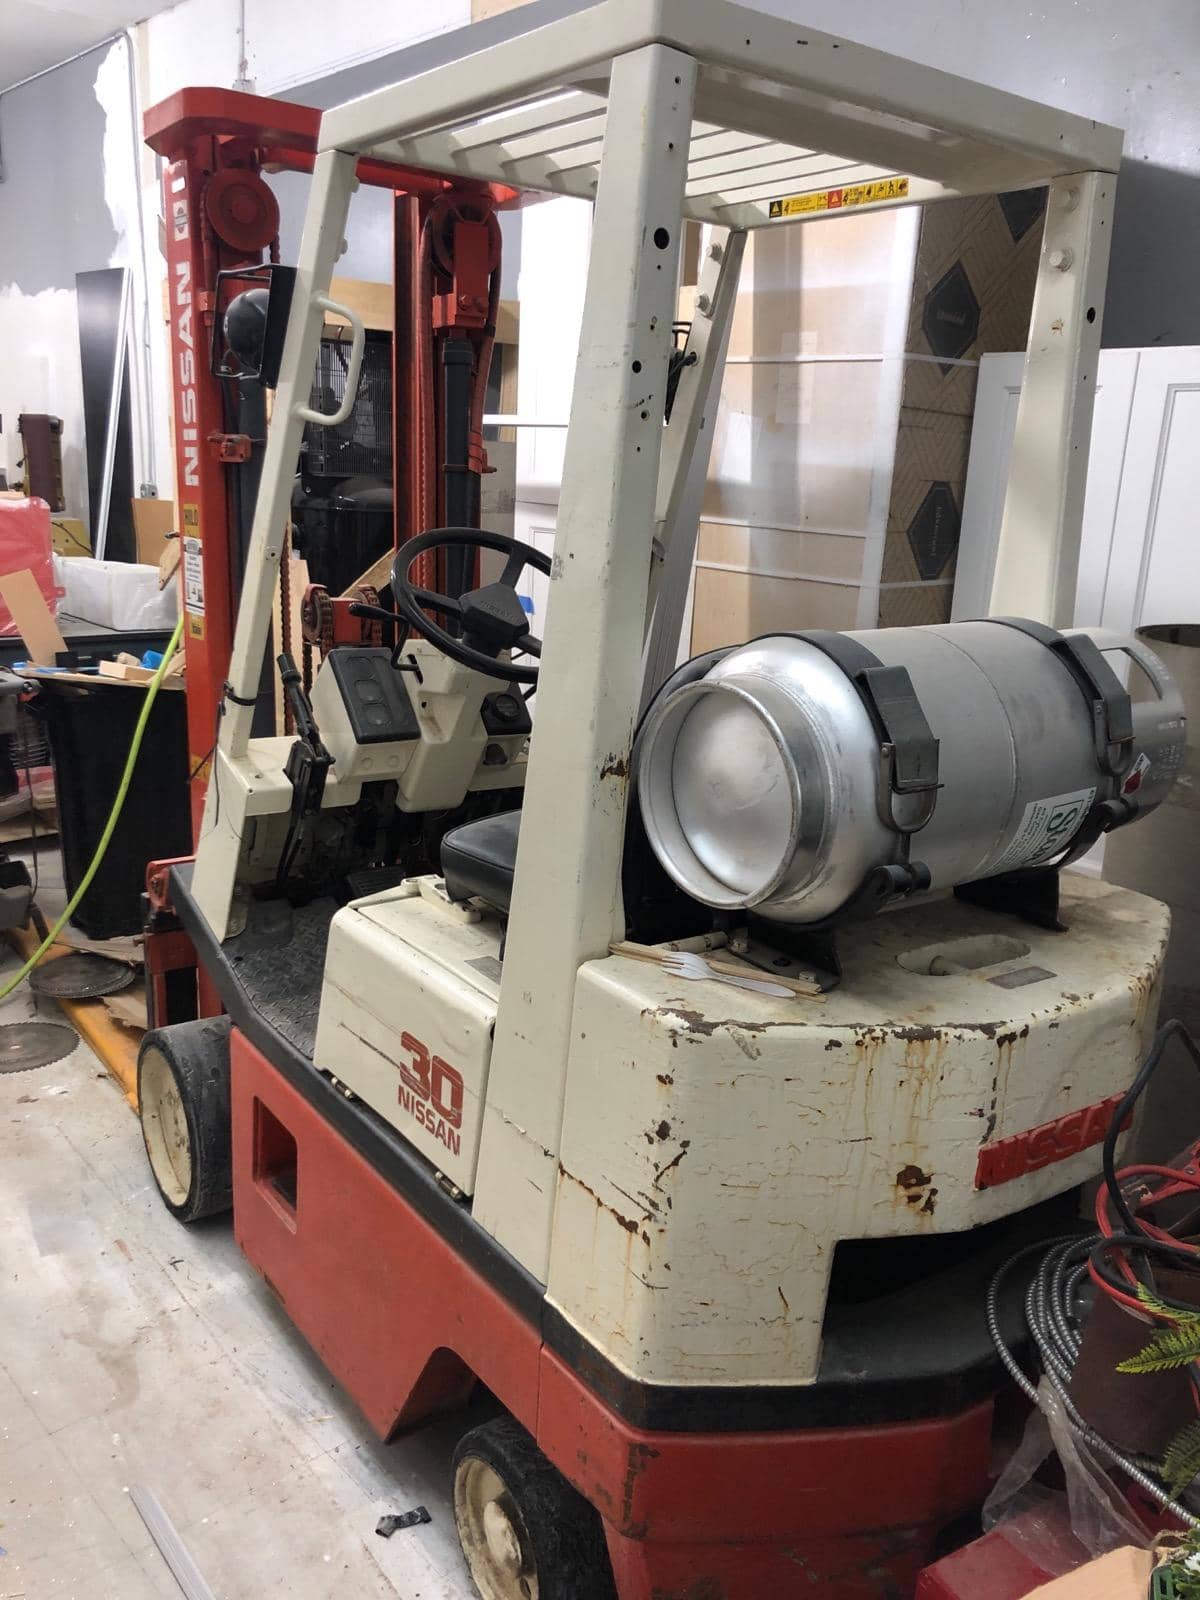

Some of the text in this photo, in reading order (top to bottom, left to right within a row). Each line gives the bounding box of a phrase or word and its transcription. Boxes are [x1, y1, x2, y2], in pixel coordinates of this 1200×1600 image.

[176, 261, 200, 487] NISSAN
[398, 1085, 461, 1156] NISSAN
[400, 1031, 464, 1129] 30
